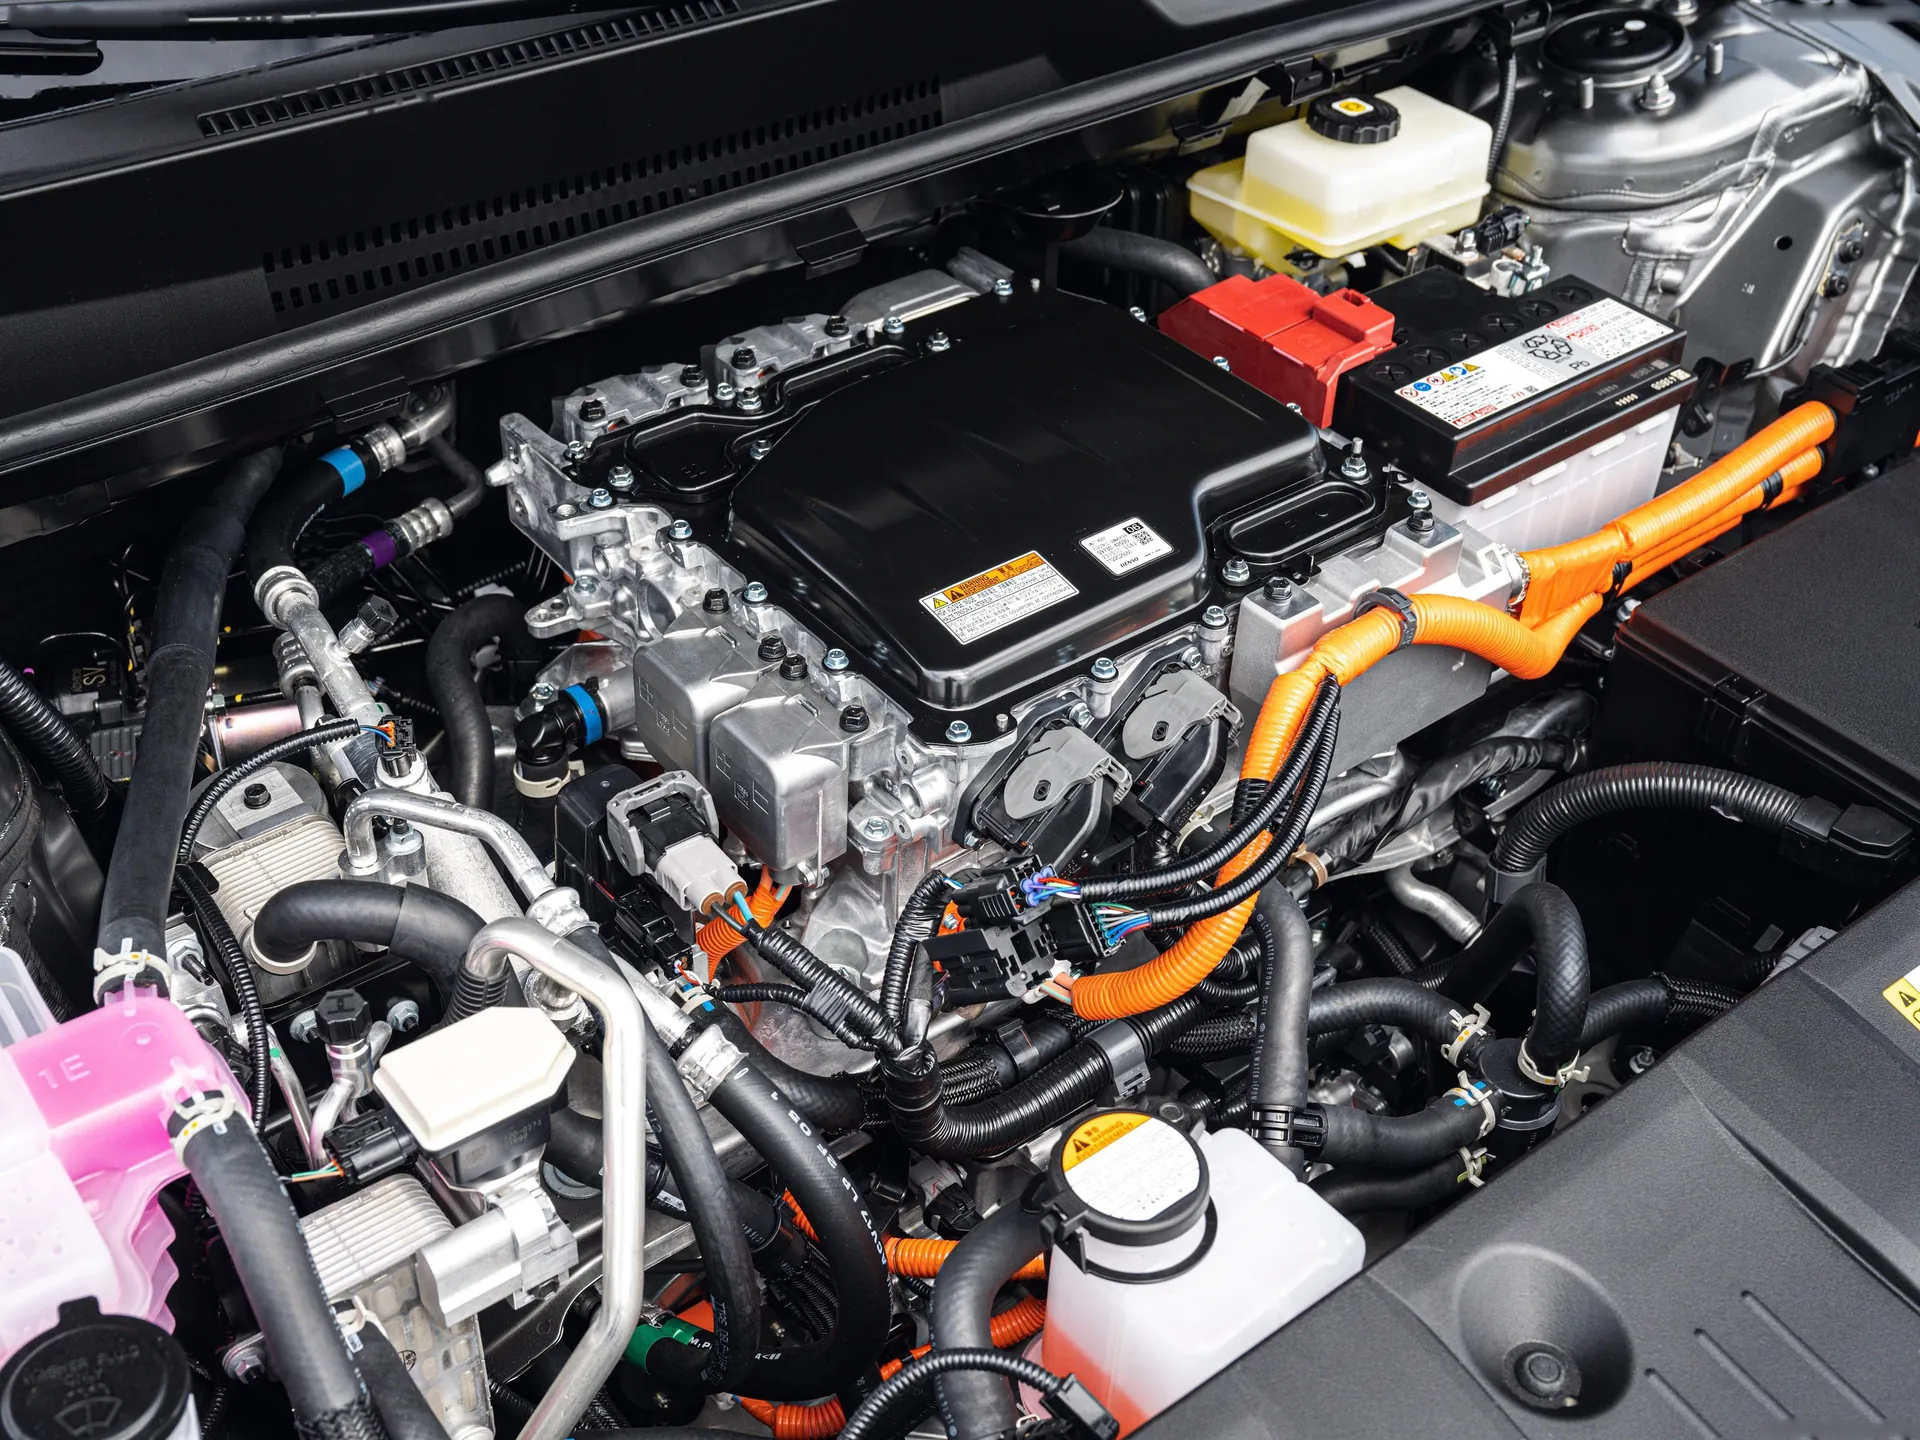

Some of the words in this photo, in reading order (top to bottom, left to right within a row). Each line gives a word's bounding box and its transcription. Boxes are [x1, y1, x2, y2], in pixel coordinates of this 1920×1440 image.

[1569, 360, 1590, 370] Pb
[1124, 523, 1141, 533] 06
[1119, 556, 1139, 567] DENSO
[958, 575, 989, 591] WARNING
[964, 576, 1000, 596] AVERTISSEMENT
[83, 668, 106, 685] SV
[38, 1054, 91, 1089] 1E
[788, 1109, 812, 1136] 05
[1091, 1121, 1124, 1142] WARNING
[1076, 1122, 1134, 1161] AVERTISSEMENT
[816, 1143, 838, 1169] 2F
[842, 1177, 858, 1202] LP
[860, 1210, 887, 1265] ACV17
